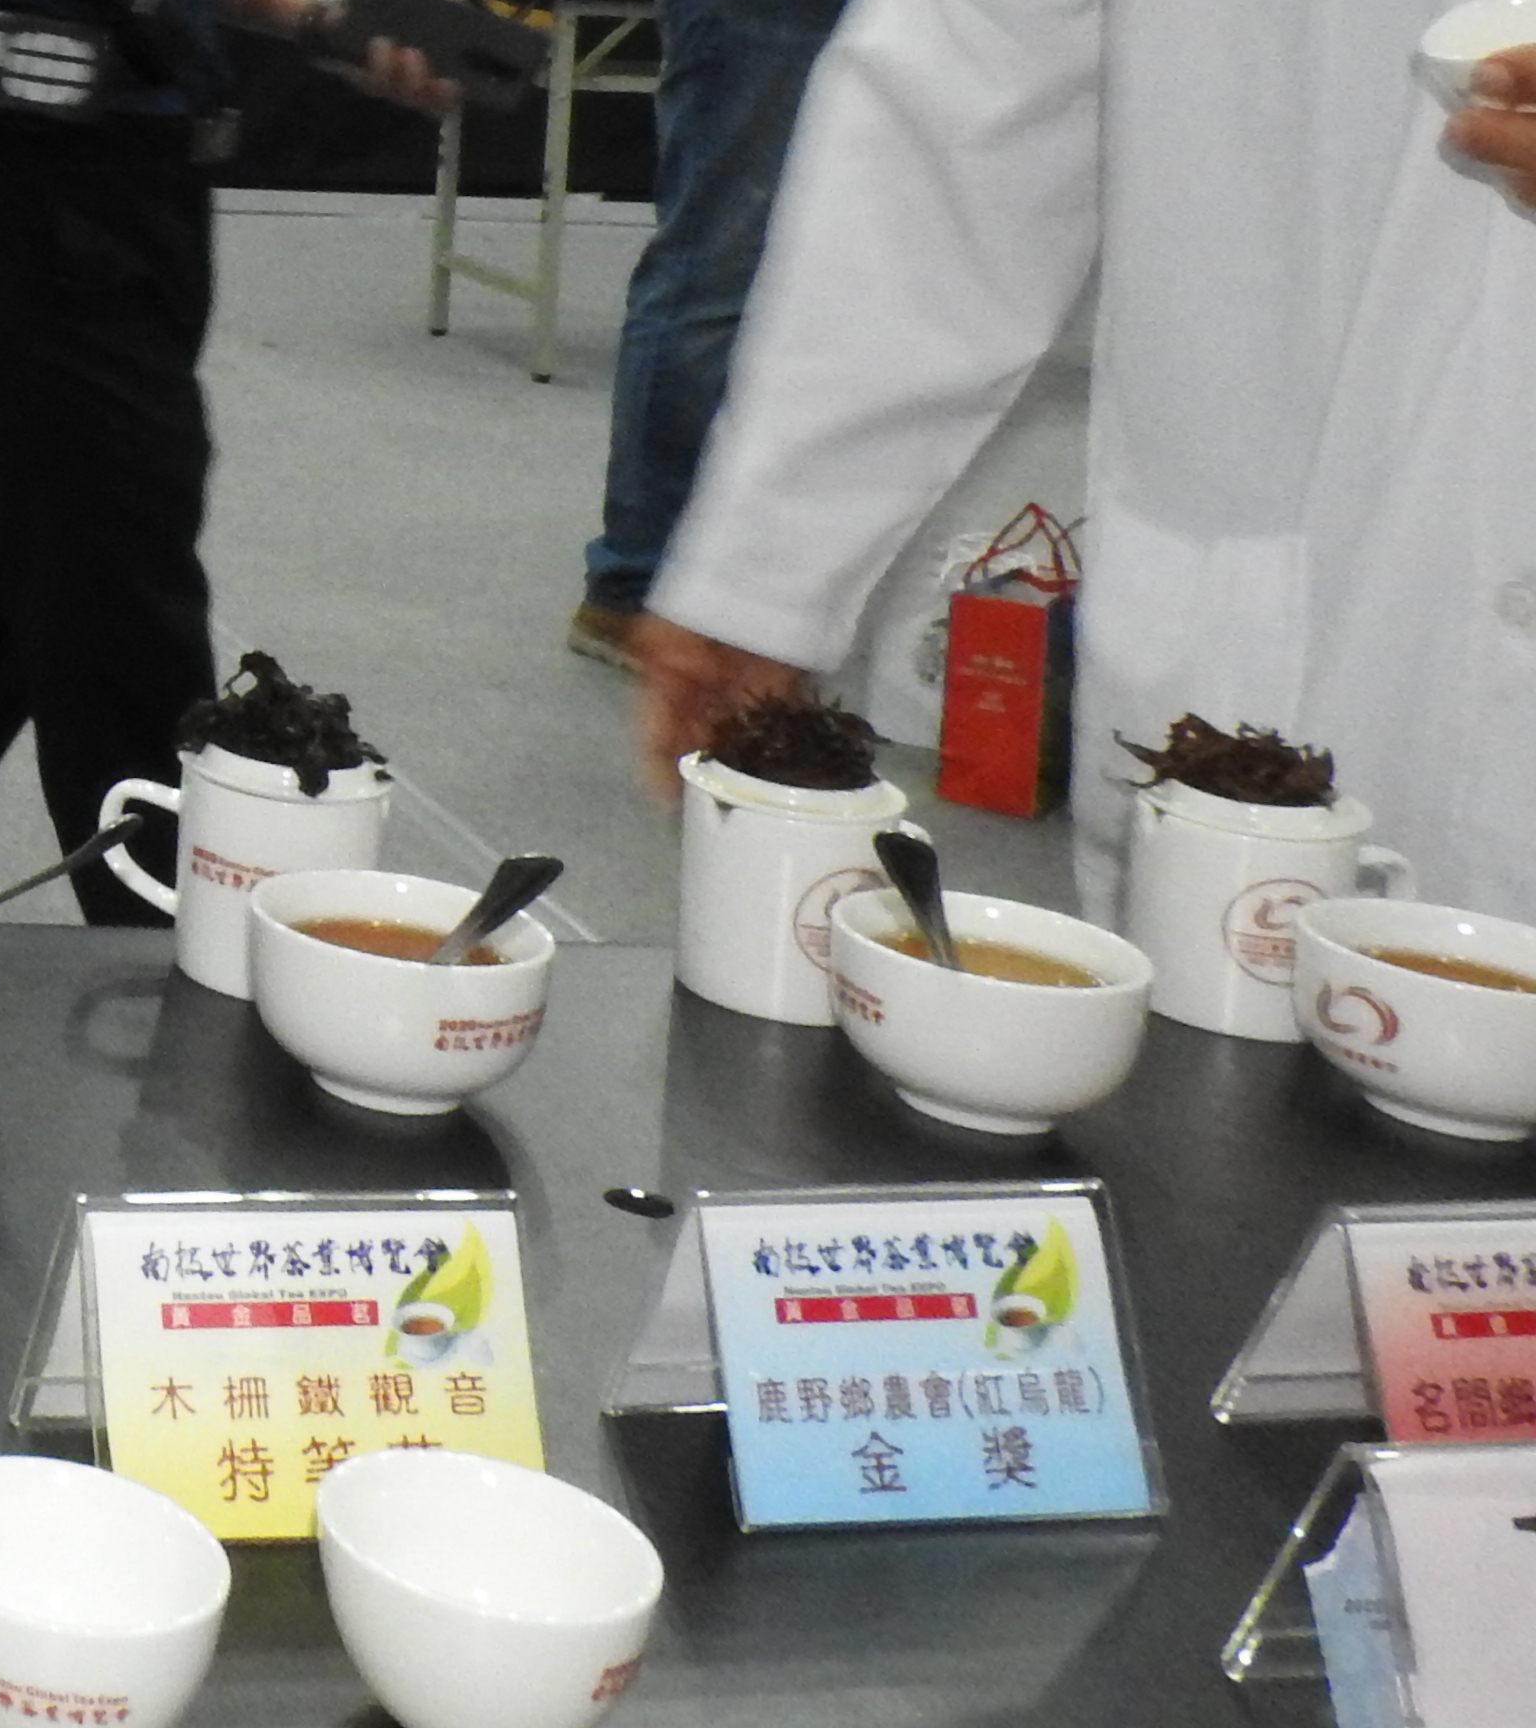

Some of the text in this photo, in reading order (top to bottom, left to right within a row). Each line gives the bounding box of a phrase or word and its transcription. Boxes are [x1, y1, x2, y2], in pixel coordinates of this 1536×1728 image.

[755, 1365, 1105, 1424] 鹿野鄉農會(紅烏龍)
[217, 1435, 444, 1504] 特等
